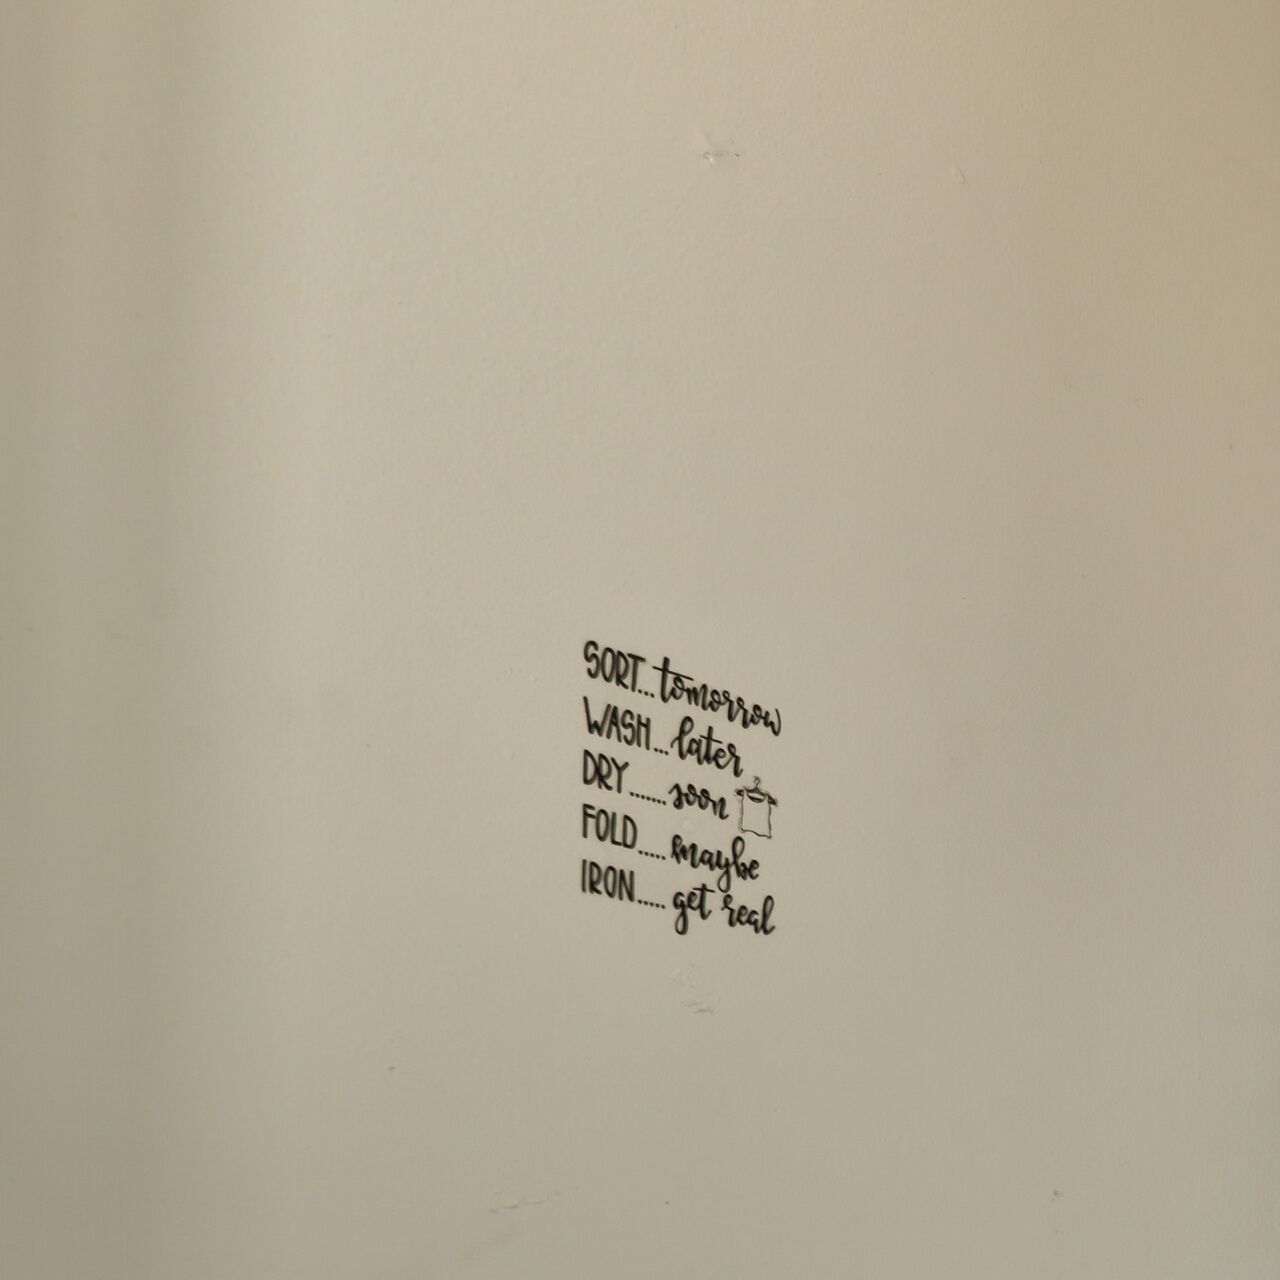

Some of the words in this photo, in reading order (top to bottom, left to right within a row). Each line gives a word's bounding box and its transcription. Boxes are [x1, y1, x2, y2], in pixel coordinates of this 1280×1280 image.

[652, 656, 782, 736] tomorrow
[670, 716, 744, 778] later
[668, 783, 730, 820] soon
[671, 834, 760, 893] maybe
[673, 883, 716, 936] get
[721, 894, 776, 936] real
